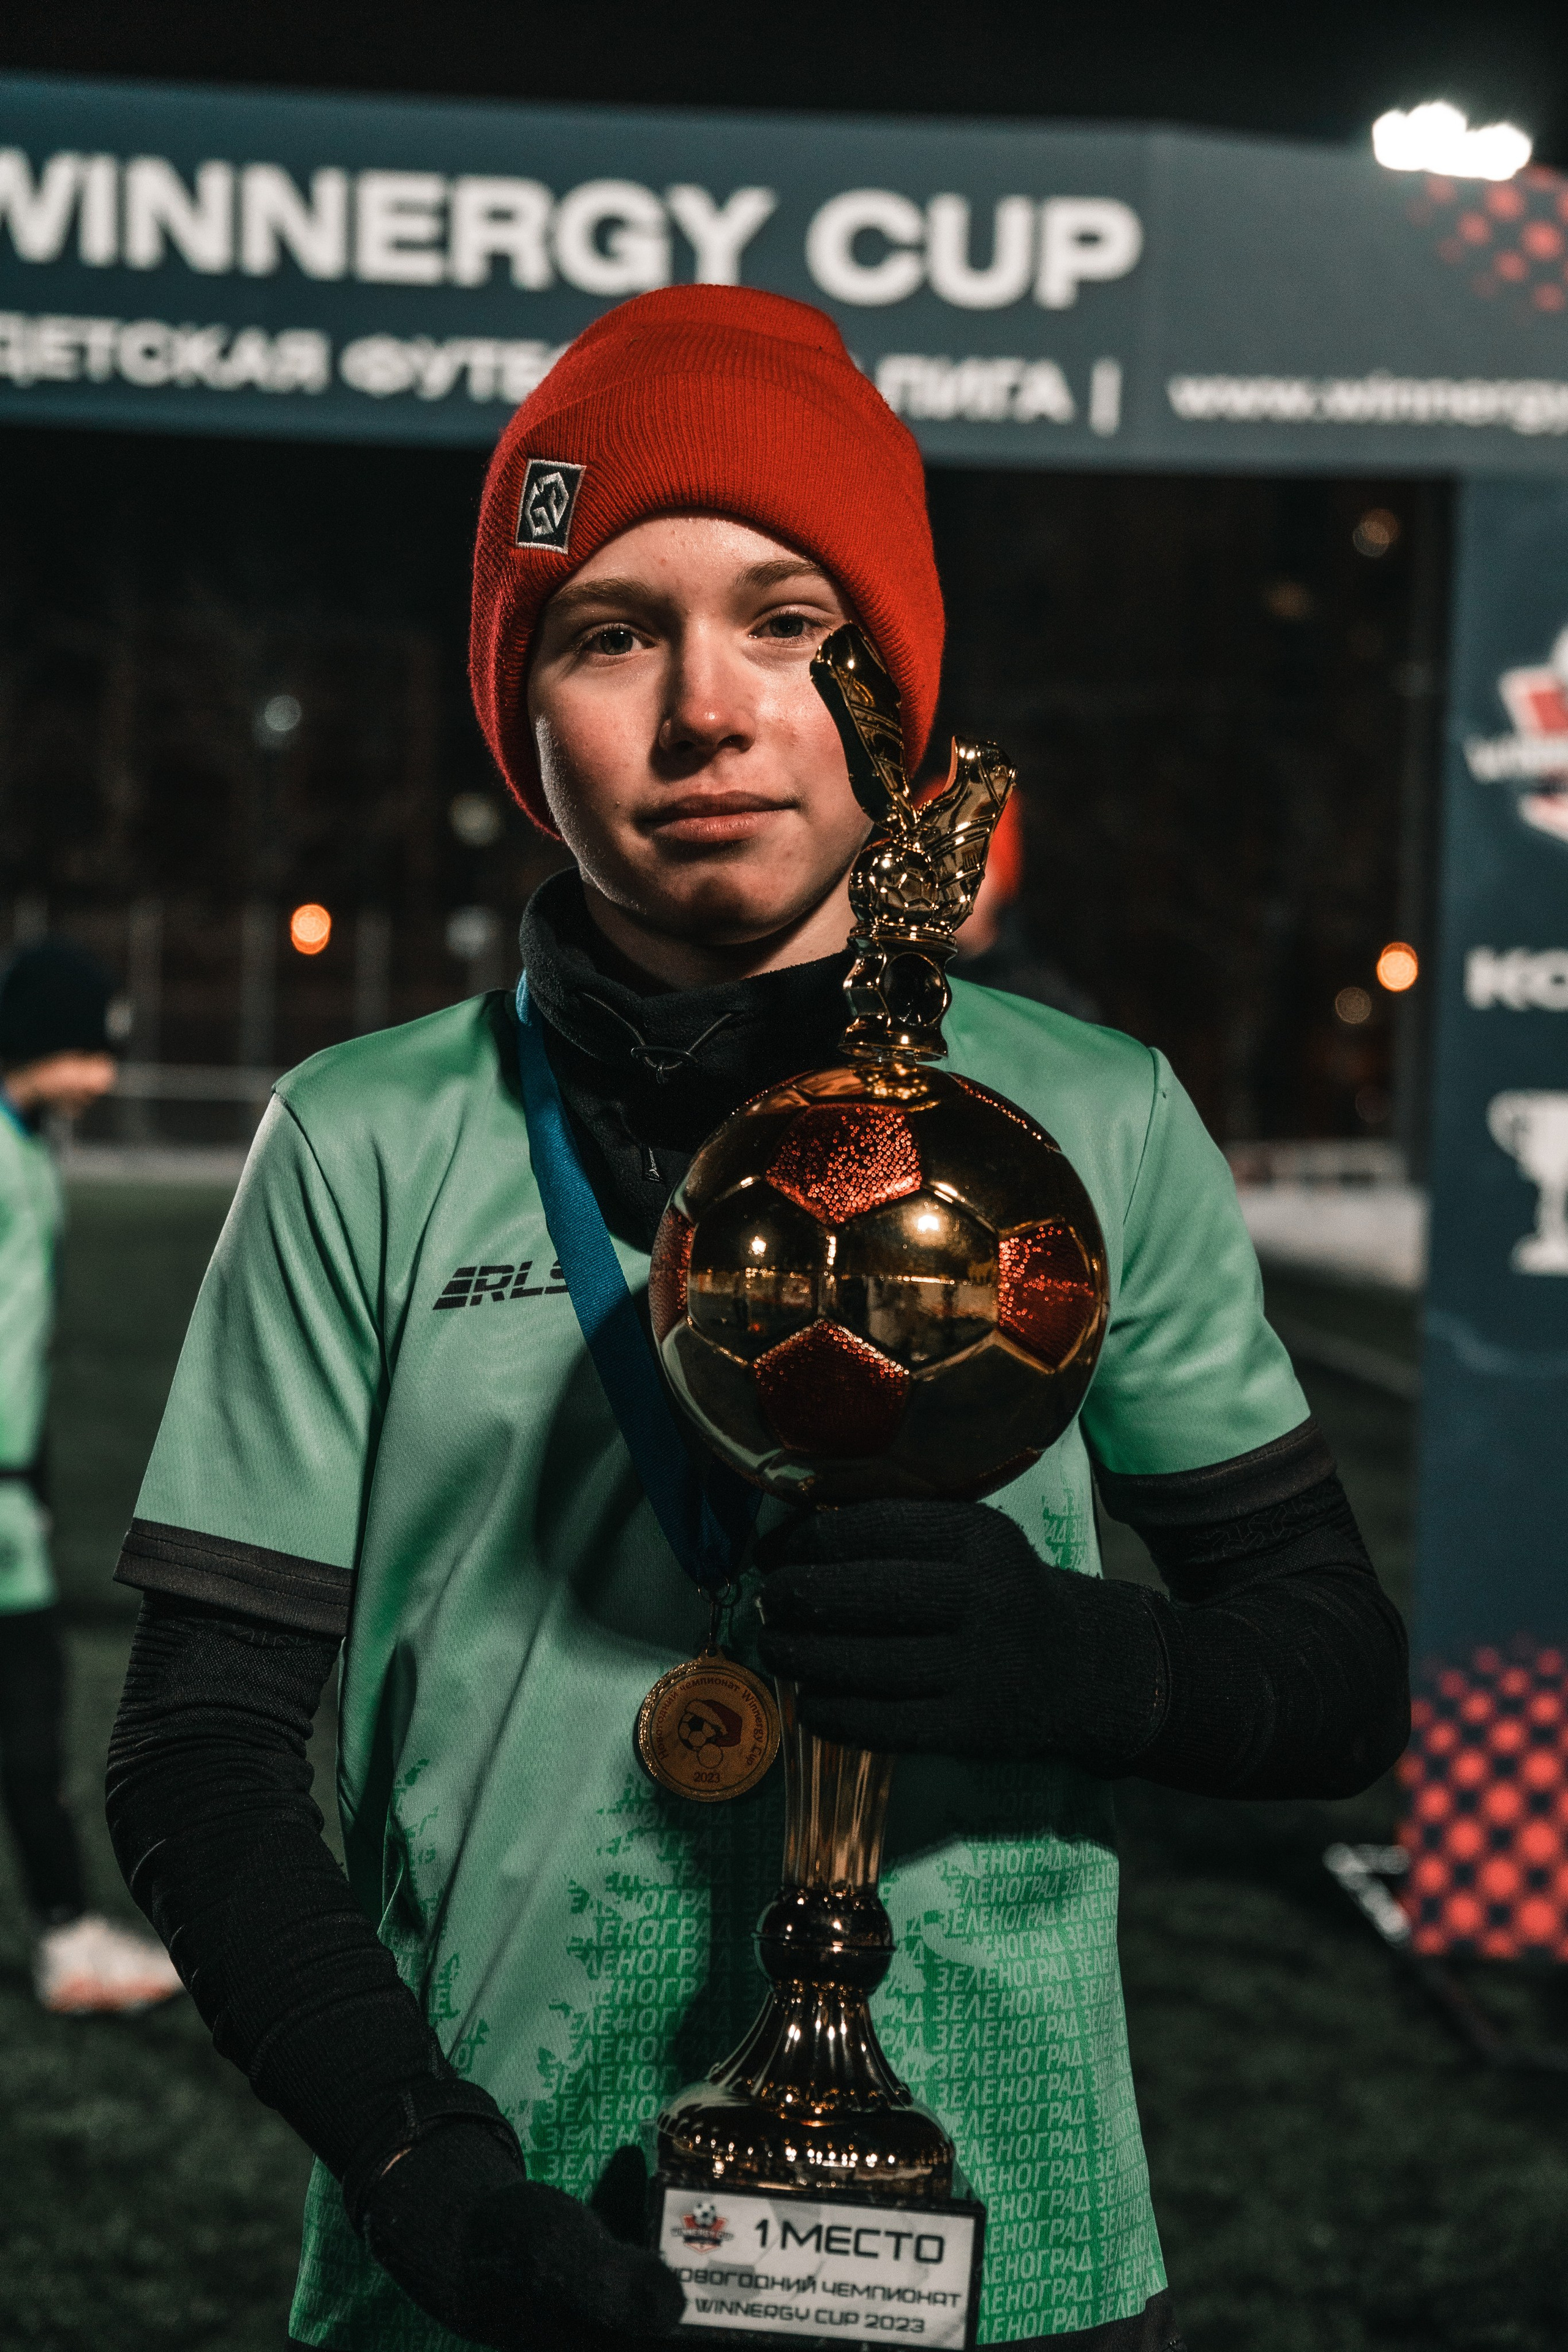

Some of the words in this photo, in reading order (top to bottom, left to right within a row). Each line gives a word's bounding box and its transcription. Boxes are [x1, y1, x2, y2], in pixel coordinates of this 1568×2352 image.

[805, 186, 1143, 310] CUP
[341, 333, 575, 404] ФУТБ
[679, 1676, 741, 1692] чемпионат
[741, 1689, 764, 1743] Winnergy
[693, 1771, 721, 1783] 2023
[948, 1874, 1059, 1907] ЕЛЕНОГРАД
[1061, 1862, 1118, 1896] ЗЕЛЕНО
[932, 1955, 1073, 1993] ЗЕЛЕНОГРАД
[932, 1982, 1077, 2022] ЗЕЛЕНОГРАД
[932, 2011, 1081, 2051] ЗЕЛЕНОГРАД
[932, 2040, 1084, 2081] ЗЕЛЕНОГРАД
[935, 2068, 1087, 2109] ЗЕЛЕНОГРАД
[950, 2098, 1087, 2139] ЕЛЕНОГРАД
[965, 2155, 1090, 2195] ЛЕНОГРАД
[755, 2218, 769, 2247] 1
[780, 2221, 946, 2264] МЕСТО
[984, 2214, 1093, 2256] ЕНОГРАД
[676, 2267, 818, 2294] ОВОГОДНИЙ
[821, 2279, 962, 2308] ЧЕМПИОНАТ
[694, 2297, 811, 2321] WINNERGY
[814, 2308, 859, 2326] CUP
[864, 2313, 925, 2335] 2023
